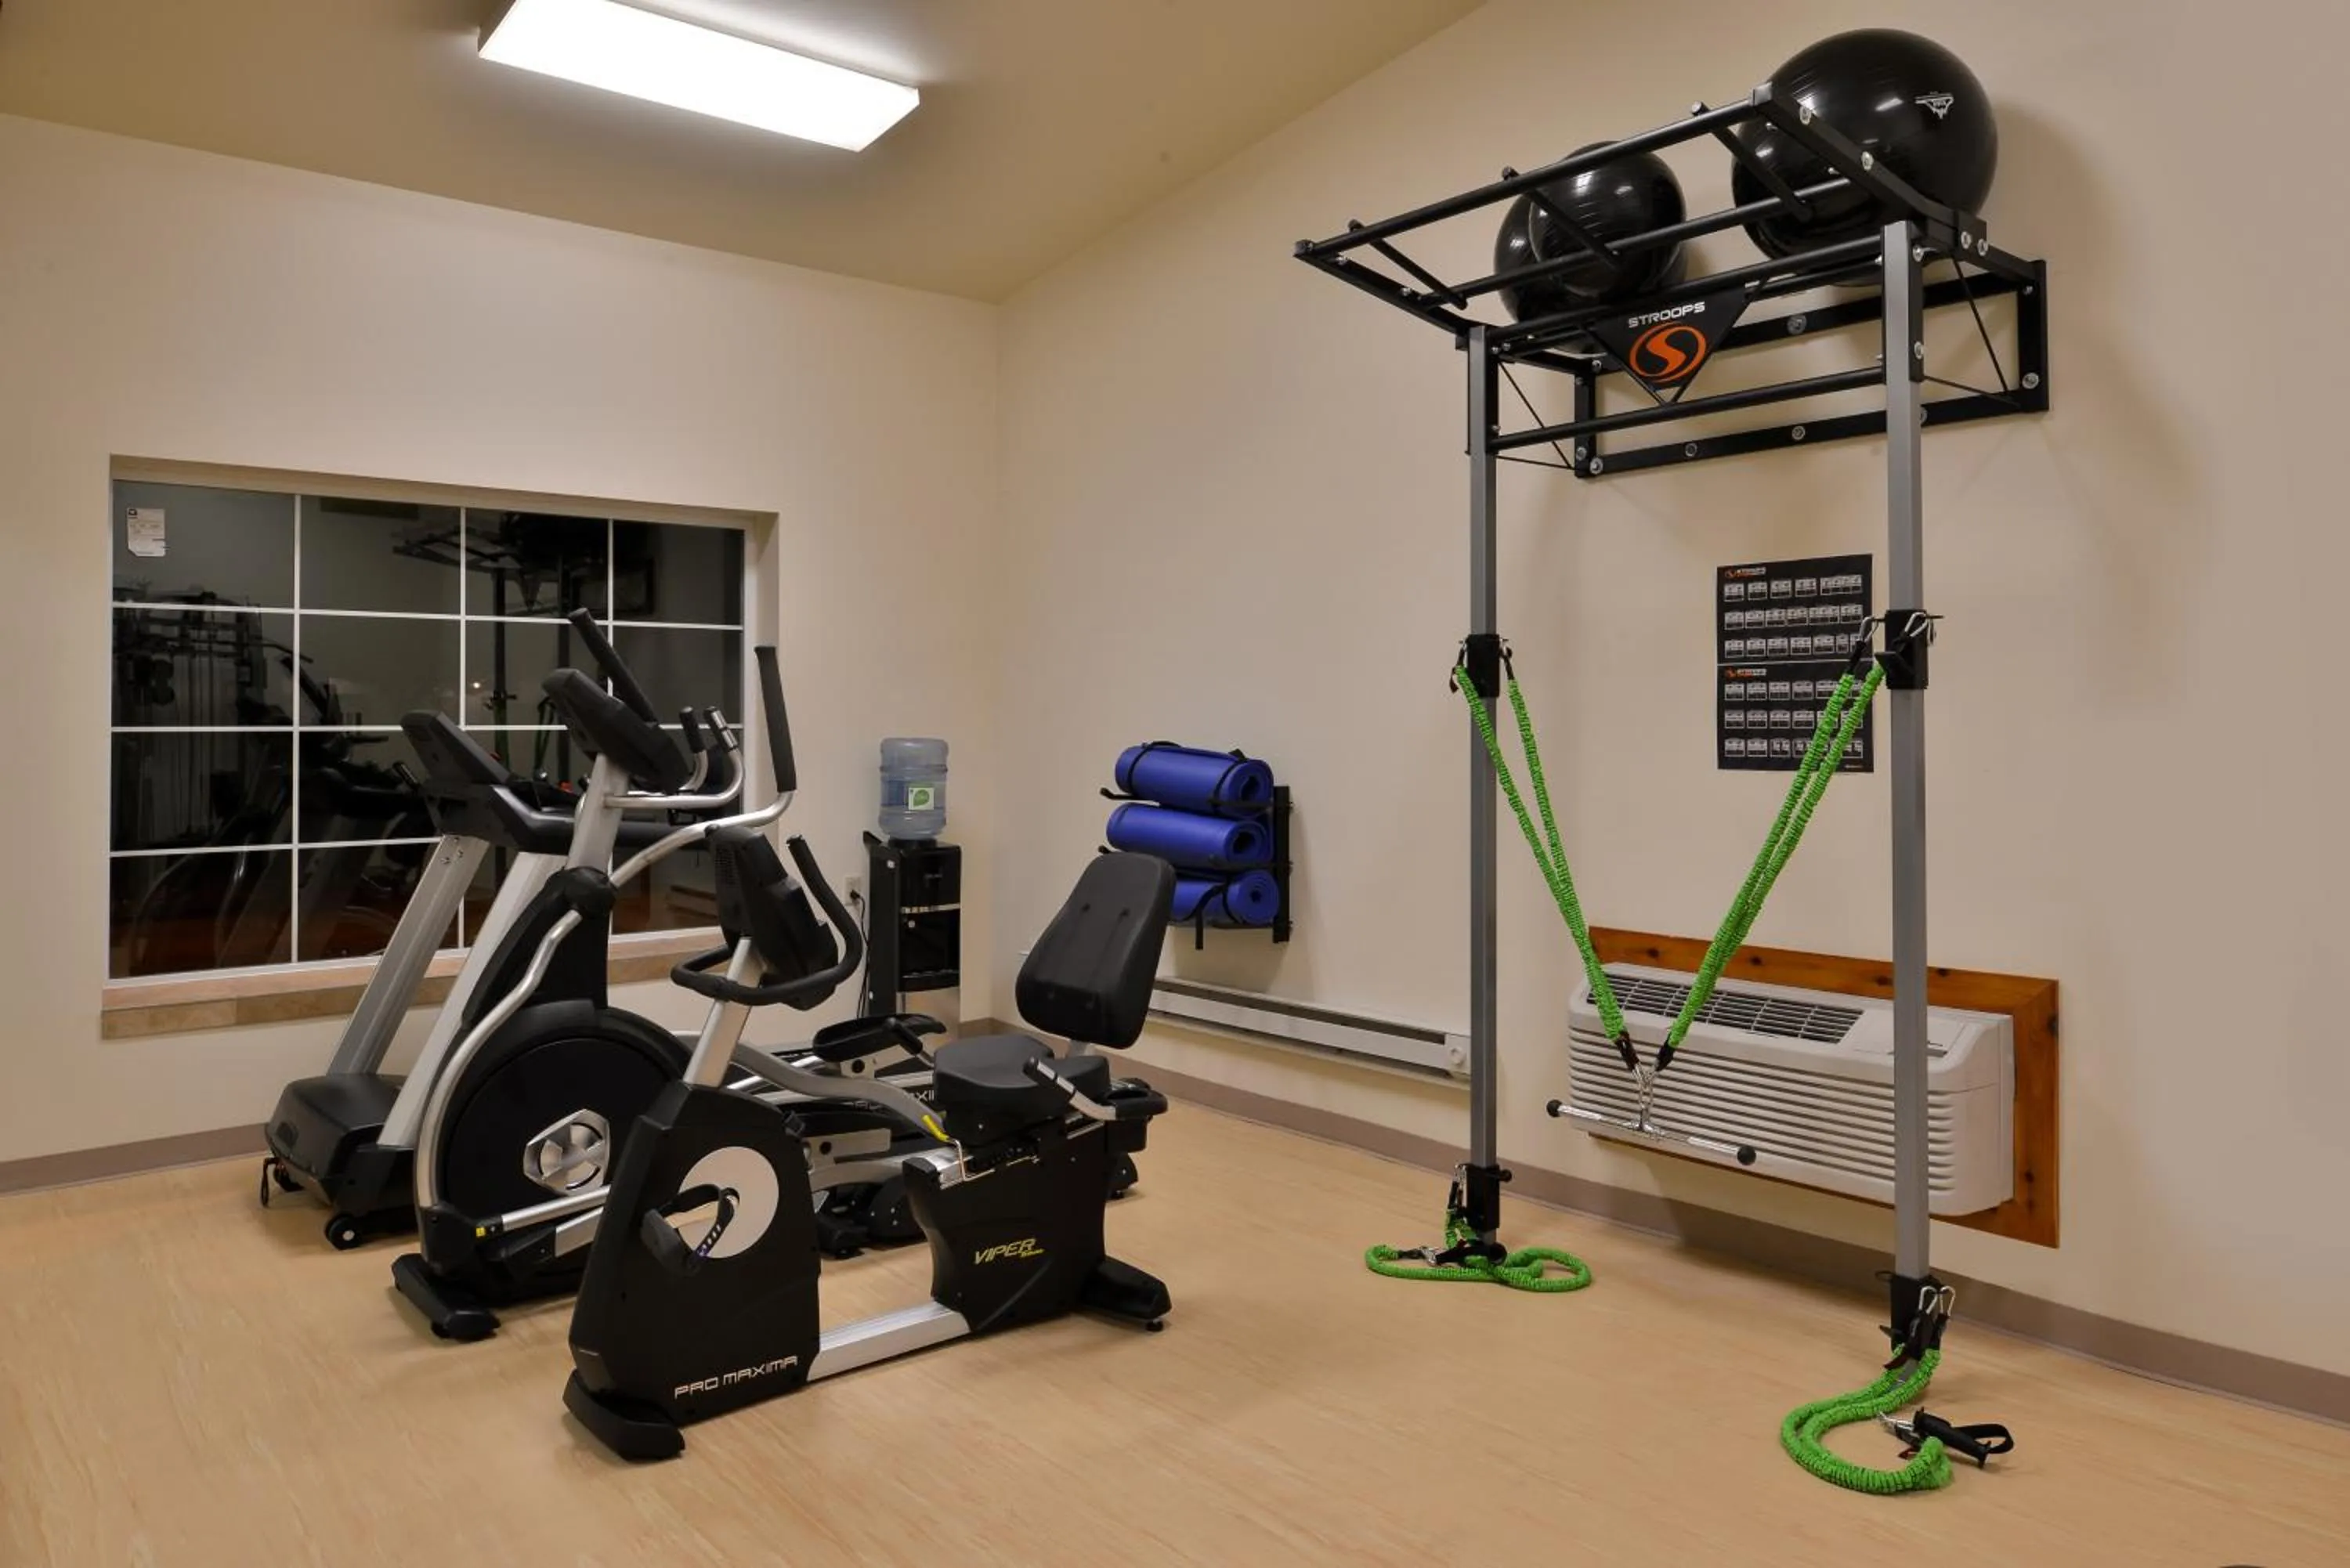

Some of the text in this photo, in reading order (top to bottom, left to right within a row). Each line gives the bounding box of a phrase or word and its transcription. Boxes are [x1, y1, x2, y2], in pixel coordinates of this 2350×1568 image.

[1628, 302, 1705, 328] STROOPS
[975, 1238, 1036, 1265] VIPER
[674, 1355, 798, 1400] PRO MAXIMA
